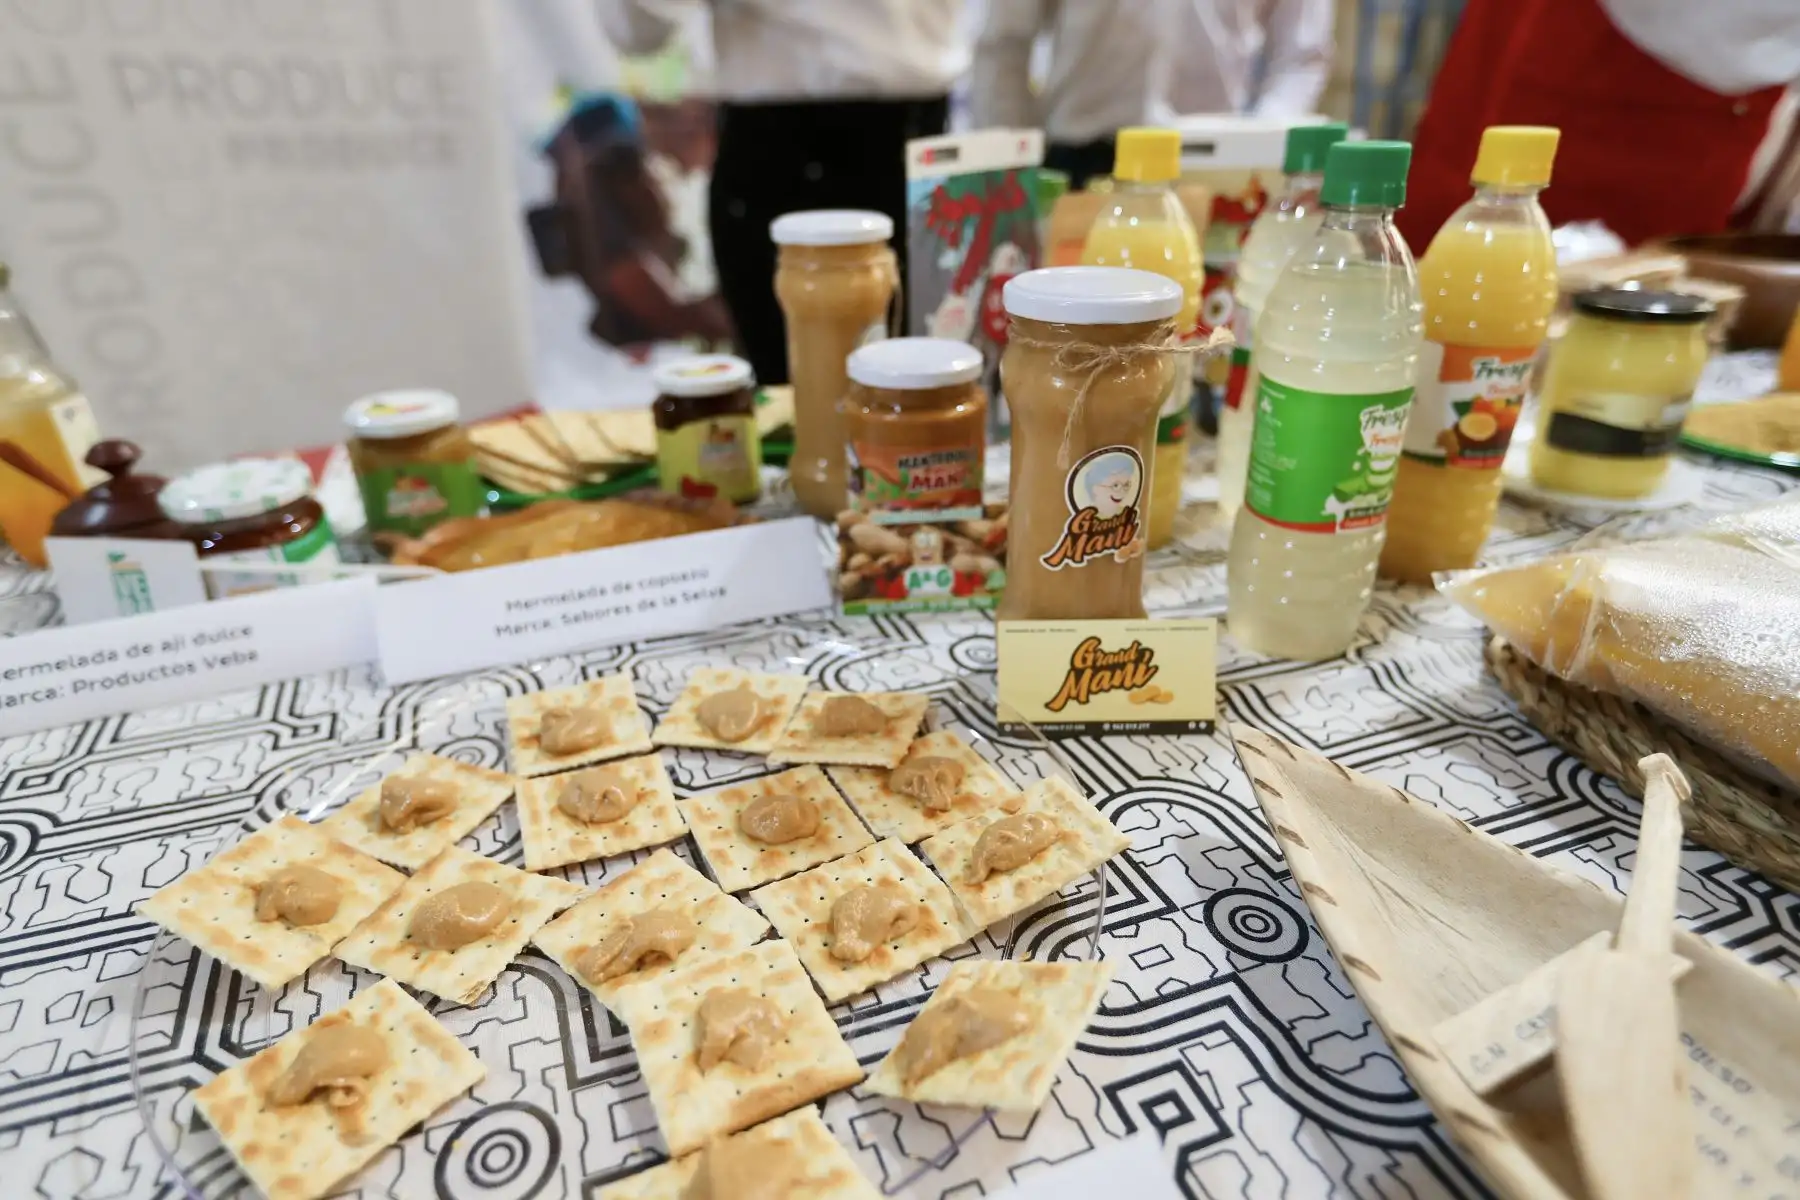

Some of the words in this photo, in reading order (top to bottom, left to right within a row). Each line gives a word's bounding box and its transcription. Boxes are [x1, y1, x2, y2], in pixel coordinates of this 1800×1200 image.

[106, 50, 466, 120] PRODUCE
[1070, 507, 1129, 535] Grand
[612, 581, 632, 595] de
[637, 598, 656, 612] de
[0, 648, 119, 682] ermelada
[126, 640, 154, 660] de
[192, 625, 254, 646] dulce
[1070, 636, 1142, 670] Grand
[0, 685, 66, 709] arca:
[72, 661, 197, 695] Productos
[202, 649, 259, 671] Veba
